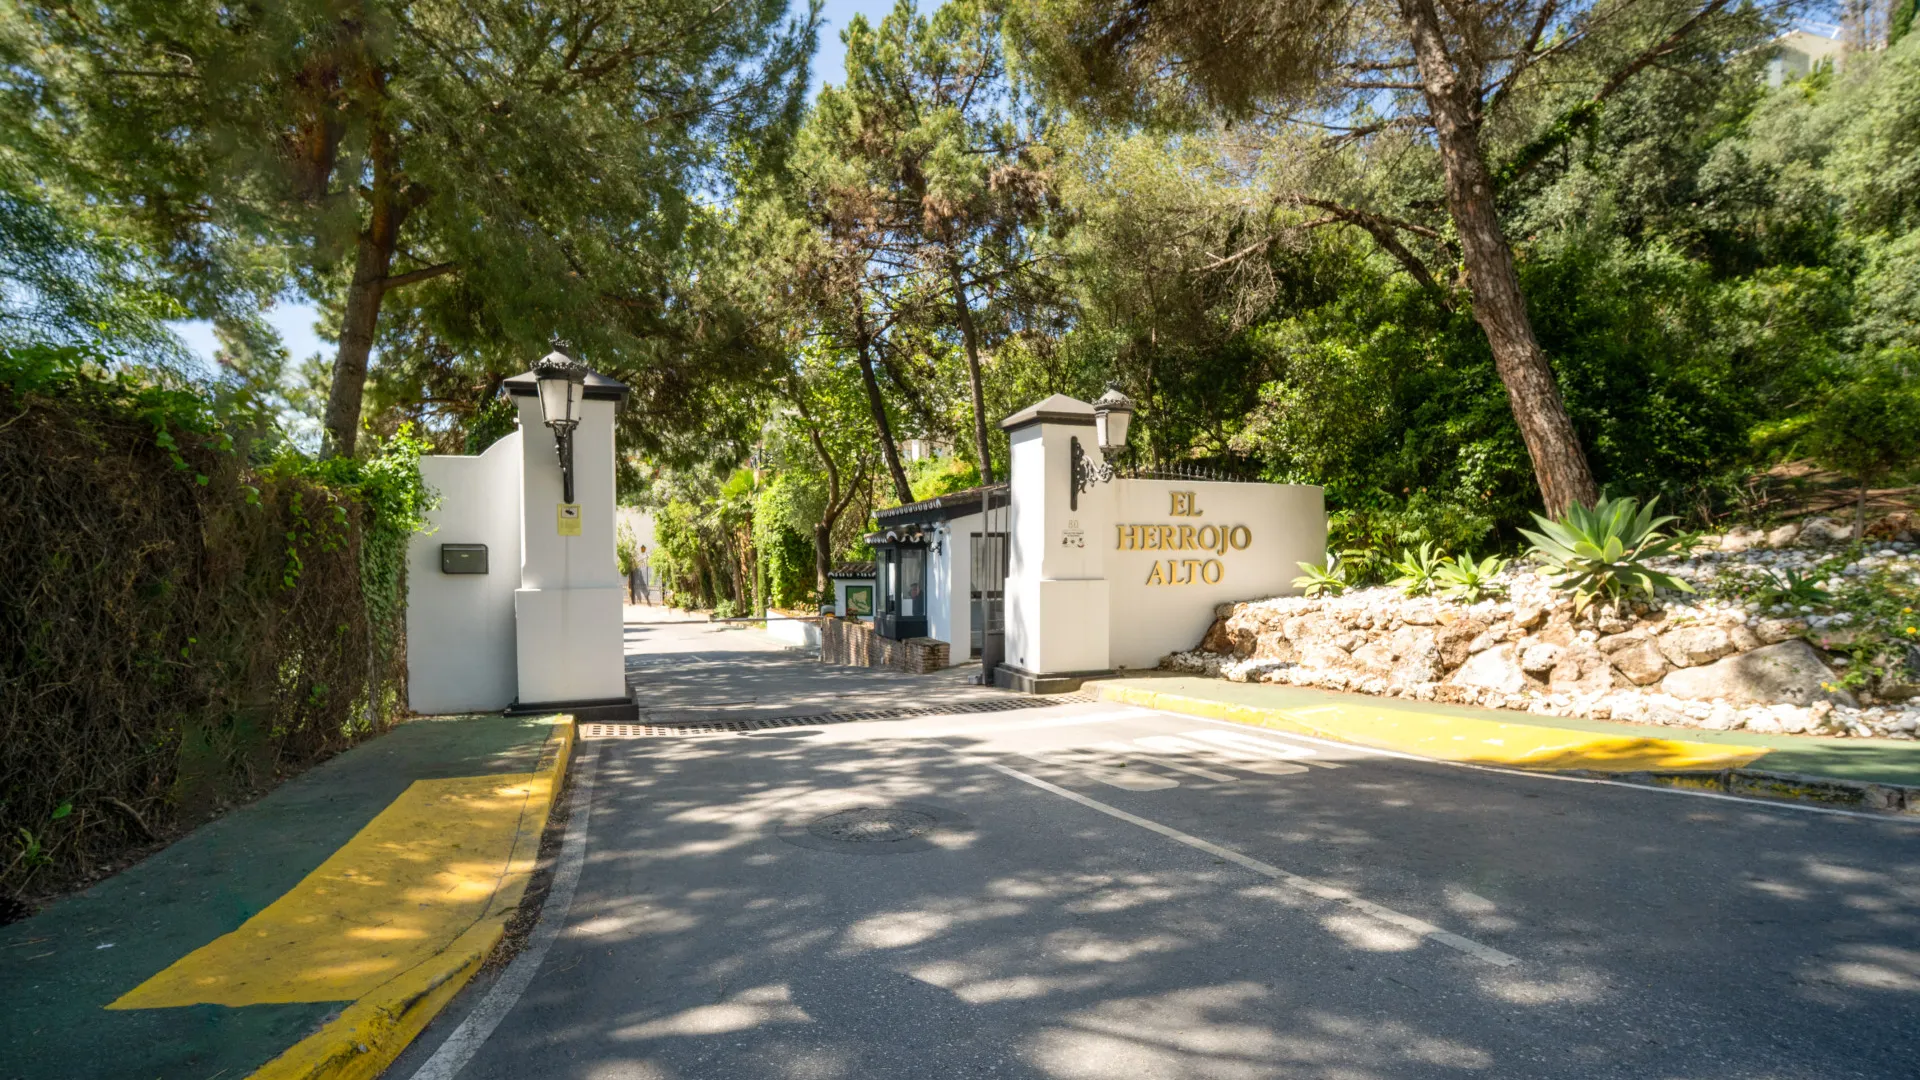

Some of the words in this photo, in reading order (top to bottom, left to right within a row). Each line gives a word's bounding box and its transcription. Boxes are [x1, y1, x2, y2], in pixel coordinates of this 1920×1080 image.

[1169, 491, 1203, 516] EL
[1115, 524, 1252, 555] HERROJO
[1146, 559, 1224, 585] ALTO
